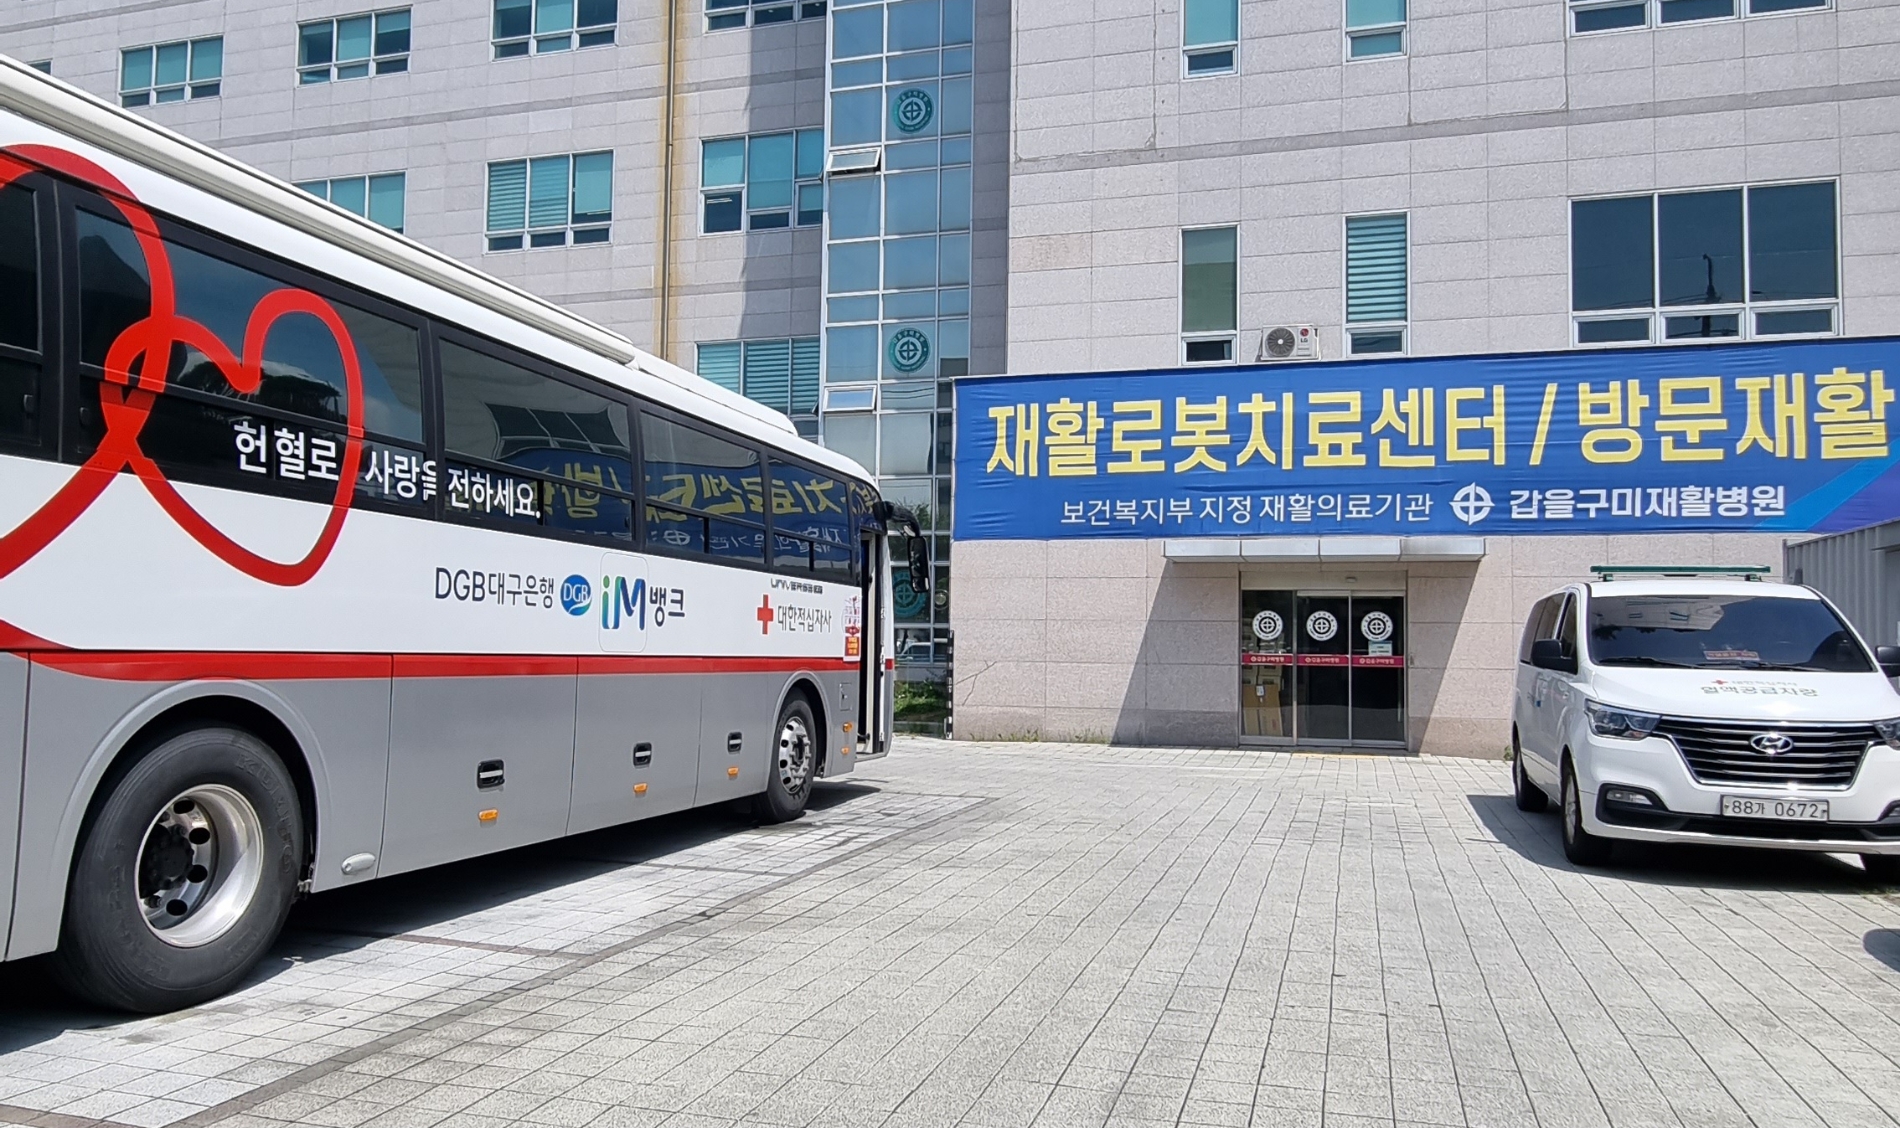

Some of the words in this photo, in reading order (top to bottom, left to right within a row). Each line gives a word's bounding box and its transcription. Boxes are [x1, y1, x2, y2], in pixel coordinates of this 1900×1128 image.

[987, 385, 1505, 477] 재활로봇치료센터
[1578, 367, 1895, 463] 방문재활
[234, 421, 339, 480] 헌혈로
[364, 450, 436, 500] 사랑을
[448, 468, 541, 519] 전하세요.
[1060, 497, 1193, 526] 보건복지부
[1200, 495, 1251, 524] 지정
[1259, 492, 1433, 522] 재활의료기관
[1509, 485, 1786, 519] 갑을구미재활병원
[435, 567, 554, 609] DGB대구은행
[562, 582, 590, 604] DGB
[777, 604, 832, 633] 대한적십자사
[1732, 800, 1765, 814] 88가
[1774, 802, 1818, 818] 0672
